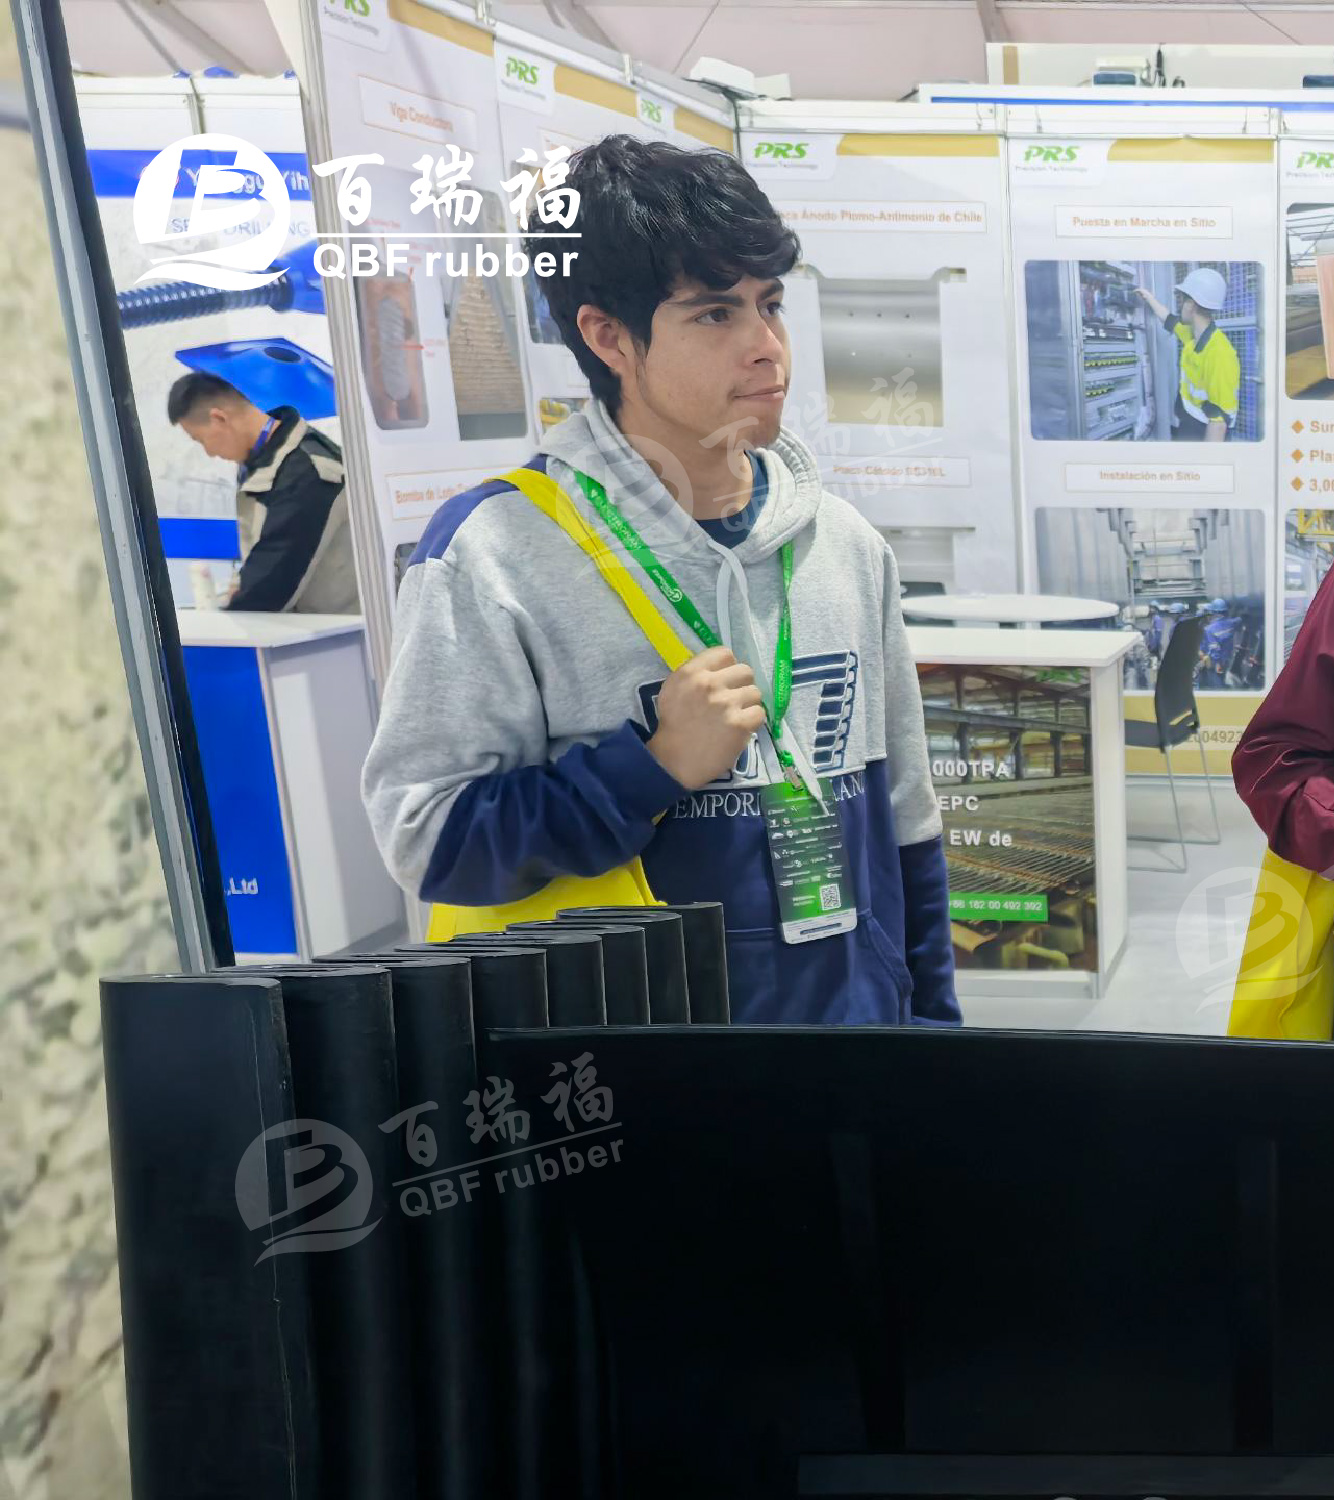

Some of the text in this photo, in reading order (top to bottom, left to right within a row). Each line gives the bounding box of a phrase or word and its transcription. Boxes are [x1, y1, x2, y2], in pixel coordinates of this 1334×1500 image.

[505, 55, 540, 85] PRS
[754, 142, 809, 159] PRS
[1024, 145, 1081, 162] PRS
[1072, 216, 1111, 228] Puesta
[1113, 218, 1128, 228] en
[1130, 216, 1171, 228] Marcha
[1173, 218, 1188, 228] en
[950, 830, 1013, 847] EW de
